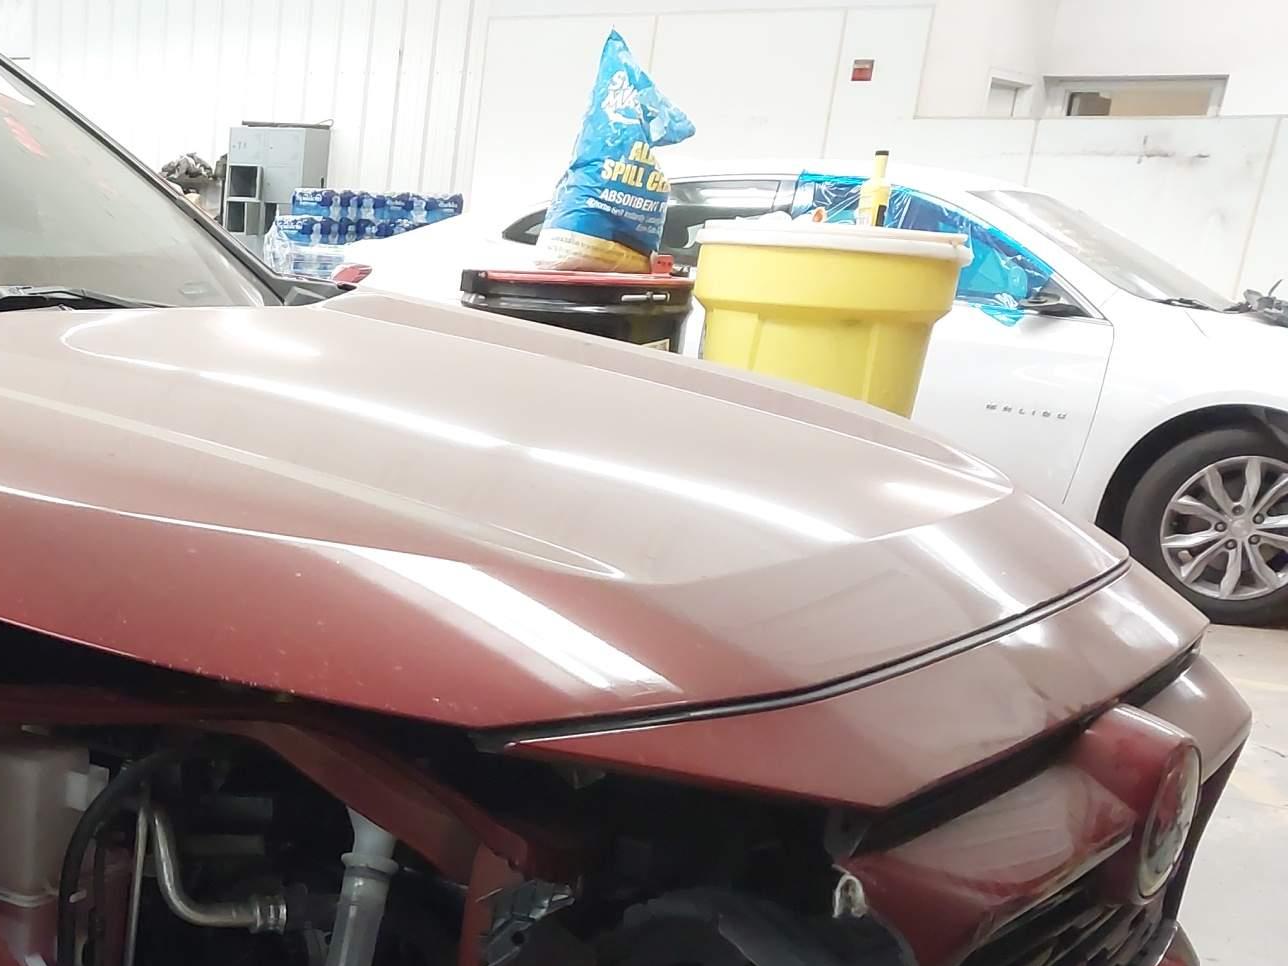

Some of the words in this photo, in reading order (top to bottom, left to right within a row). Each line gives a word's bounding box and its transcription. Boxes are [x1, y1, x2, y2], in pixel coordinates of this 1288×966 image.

[601, 157, 645, 188] SPILL
[600, 188, 658, 213] ABSORBENT
[985, 404, 1068, 420] MALIBU
